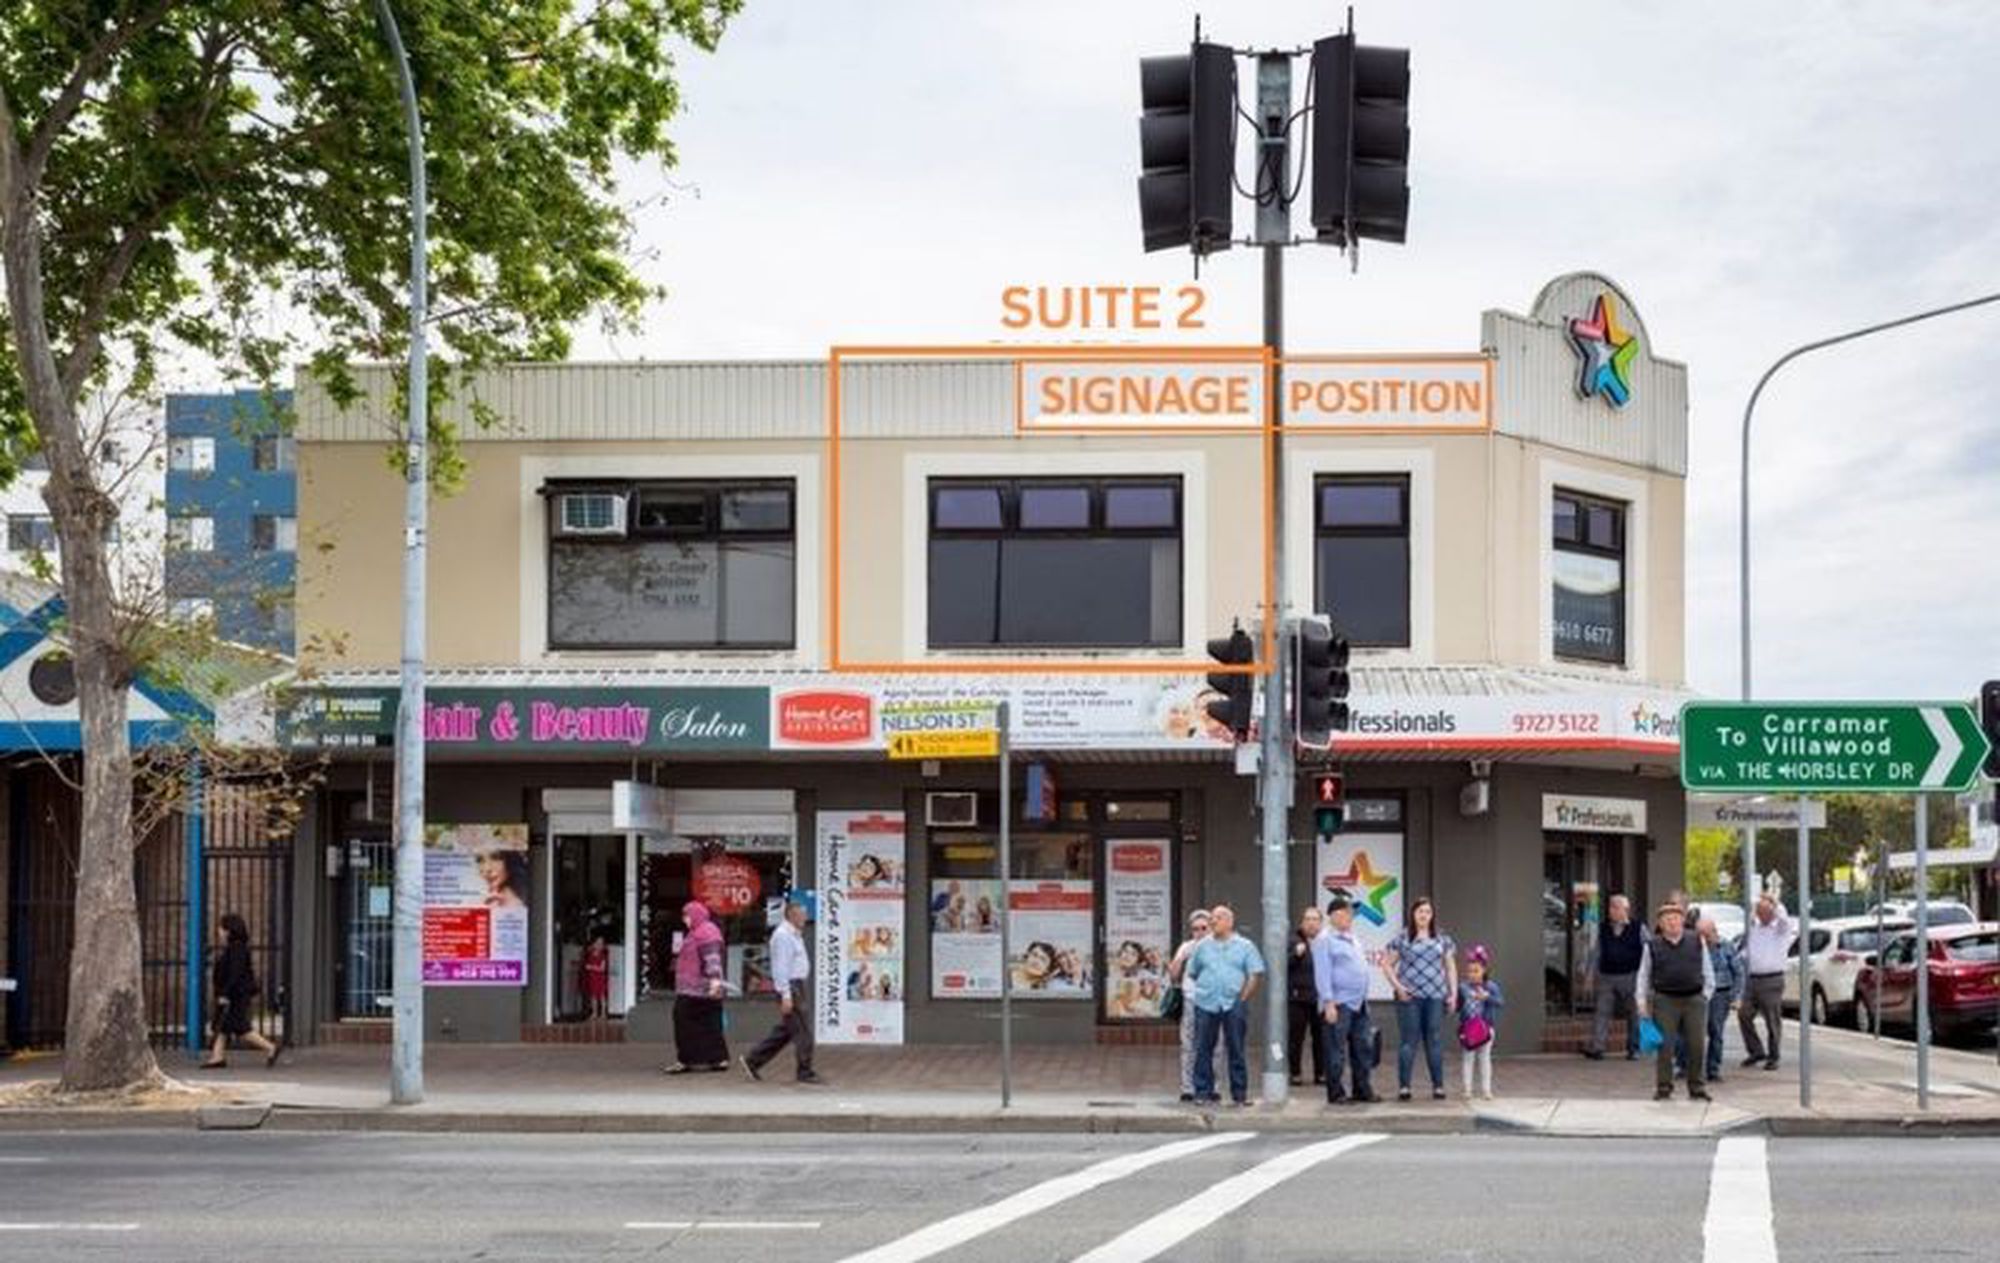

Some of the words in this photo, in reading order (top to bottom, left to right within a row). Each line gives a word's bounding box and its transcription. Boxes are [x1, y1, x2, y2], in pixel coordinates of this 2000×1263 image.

[784, 703, 827, 720] Home
[829, 703, 866, 721] Care
[881, 713, 953, 731] NELSON
[957, 712, 979, 729] ST
[1350, 710, 1456, 733] fessionals
[1512, 712, 1555, 732] 9727
[1558, 712, 1600, 733] 5122
[490, 701, 519, 741] &
[531, 701, 650, 745] Beauty
[660, 705, 748, 740] Salon
[1762, 713, 1890, 734] Carramar
[1715, 726, 1747, 746] To
[1762, 737, 1892, 756] Villawood
[1700, 766, 1726, 779] VIA
[1737, 763, 1772, 780] THE
[1784, 762, 1876, 780] HORSLEY
[1888, 762, 1914, 780] DR
[827, 934, 841, 1027] ASSISTANCE
